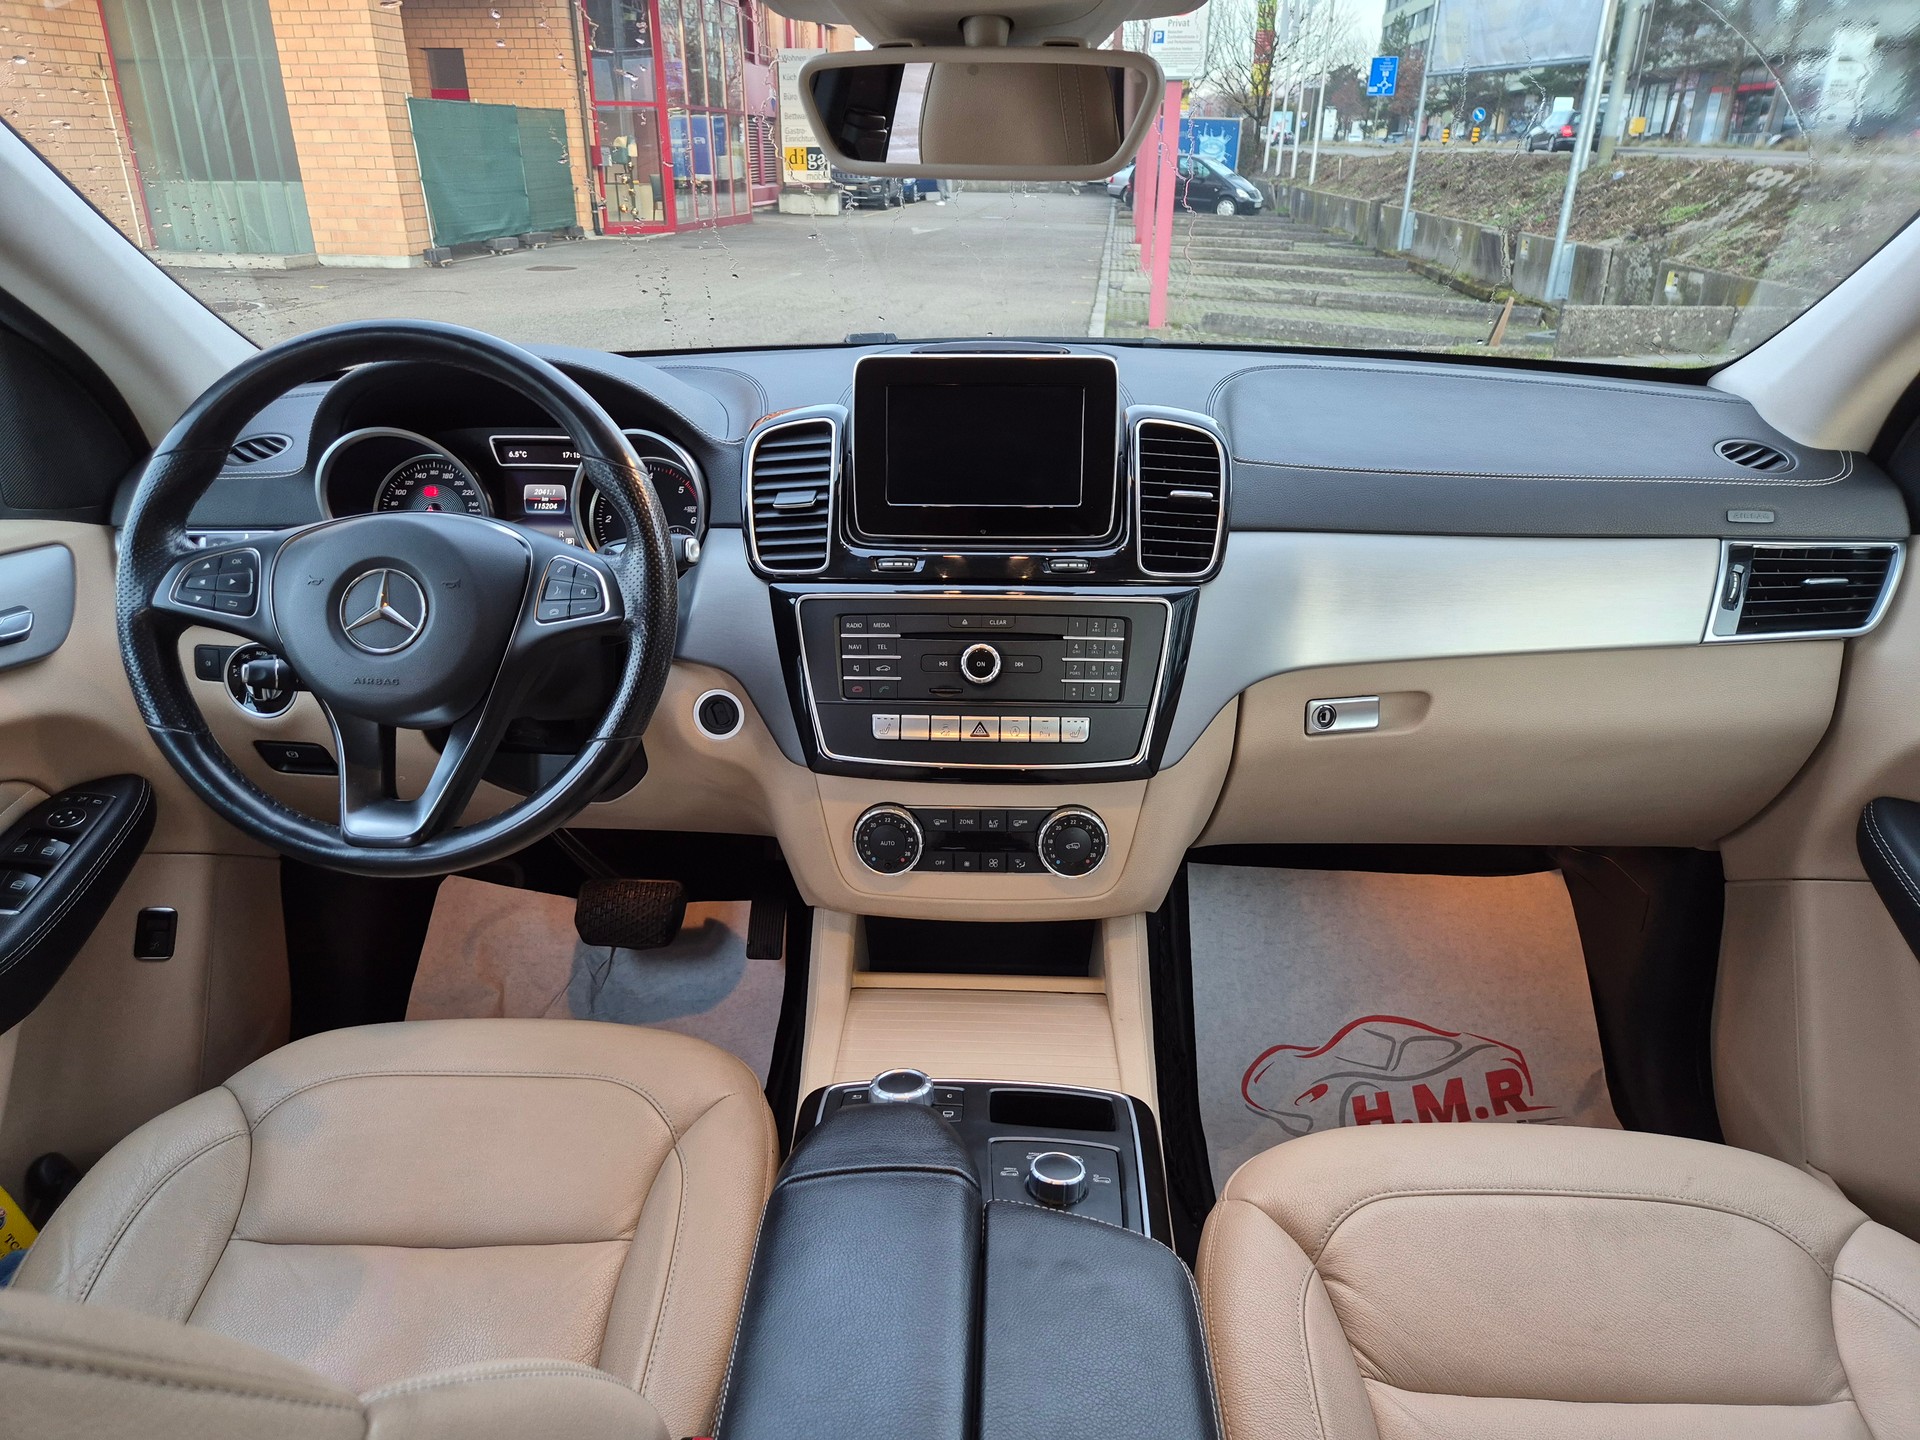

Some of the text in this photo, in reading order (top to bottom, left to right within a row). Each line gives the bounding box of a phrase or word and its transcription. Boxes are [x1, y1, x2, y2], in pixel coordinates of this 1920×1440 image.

[1167, 19, 1190, 27] Privat
[783, 92, 798, 101] Büro
[789, 148, 826, 170] diga
[678, 485, 685, 494] 5
[533, 502, 558, 510] 115204
[605, 515, 612, 523] 2
[690, 516, 697, 524] 6
[353, 677, 400, 686] AIRBAG
